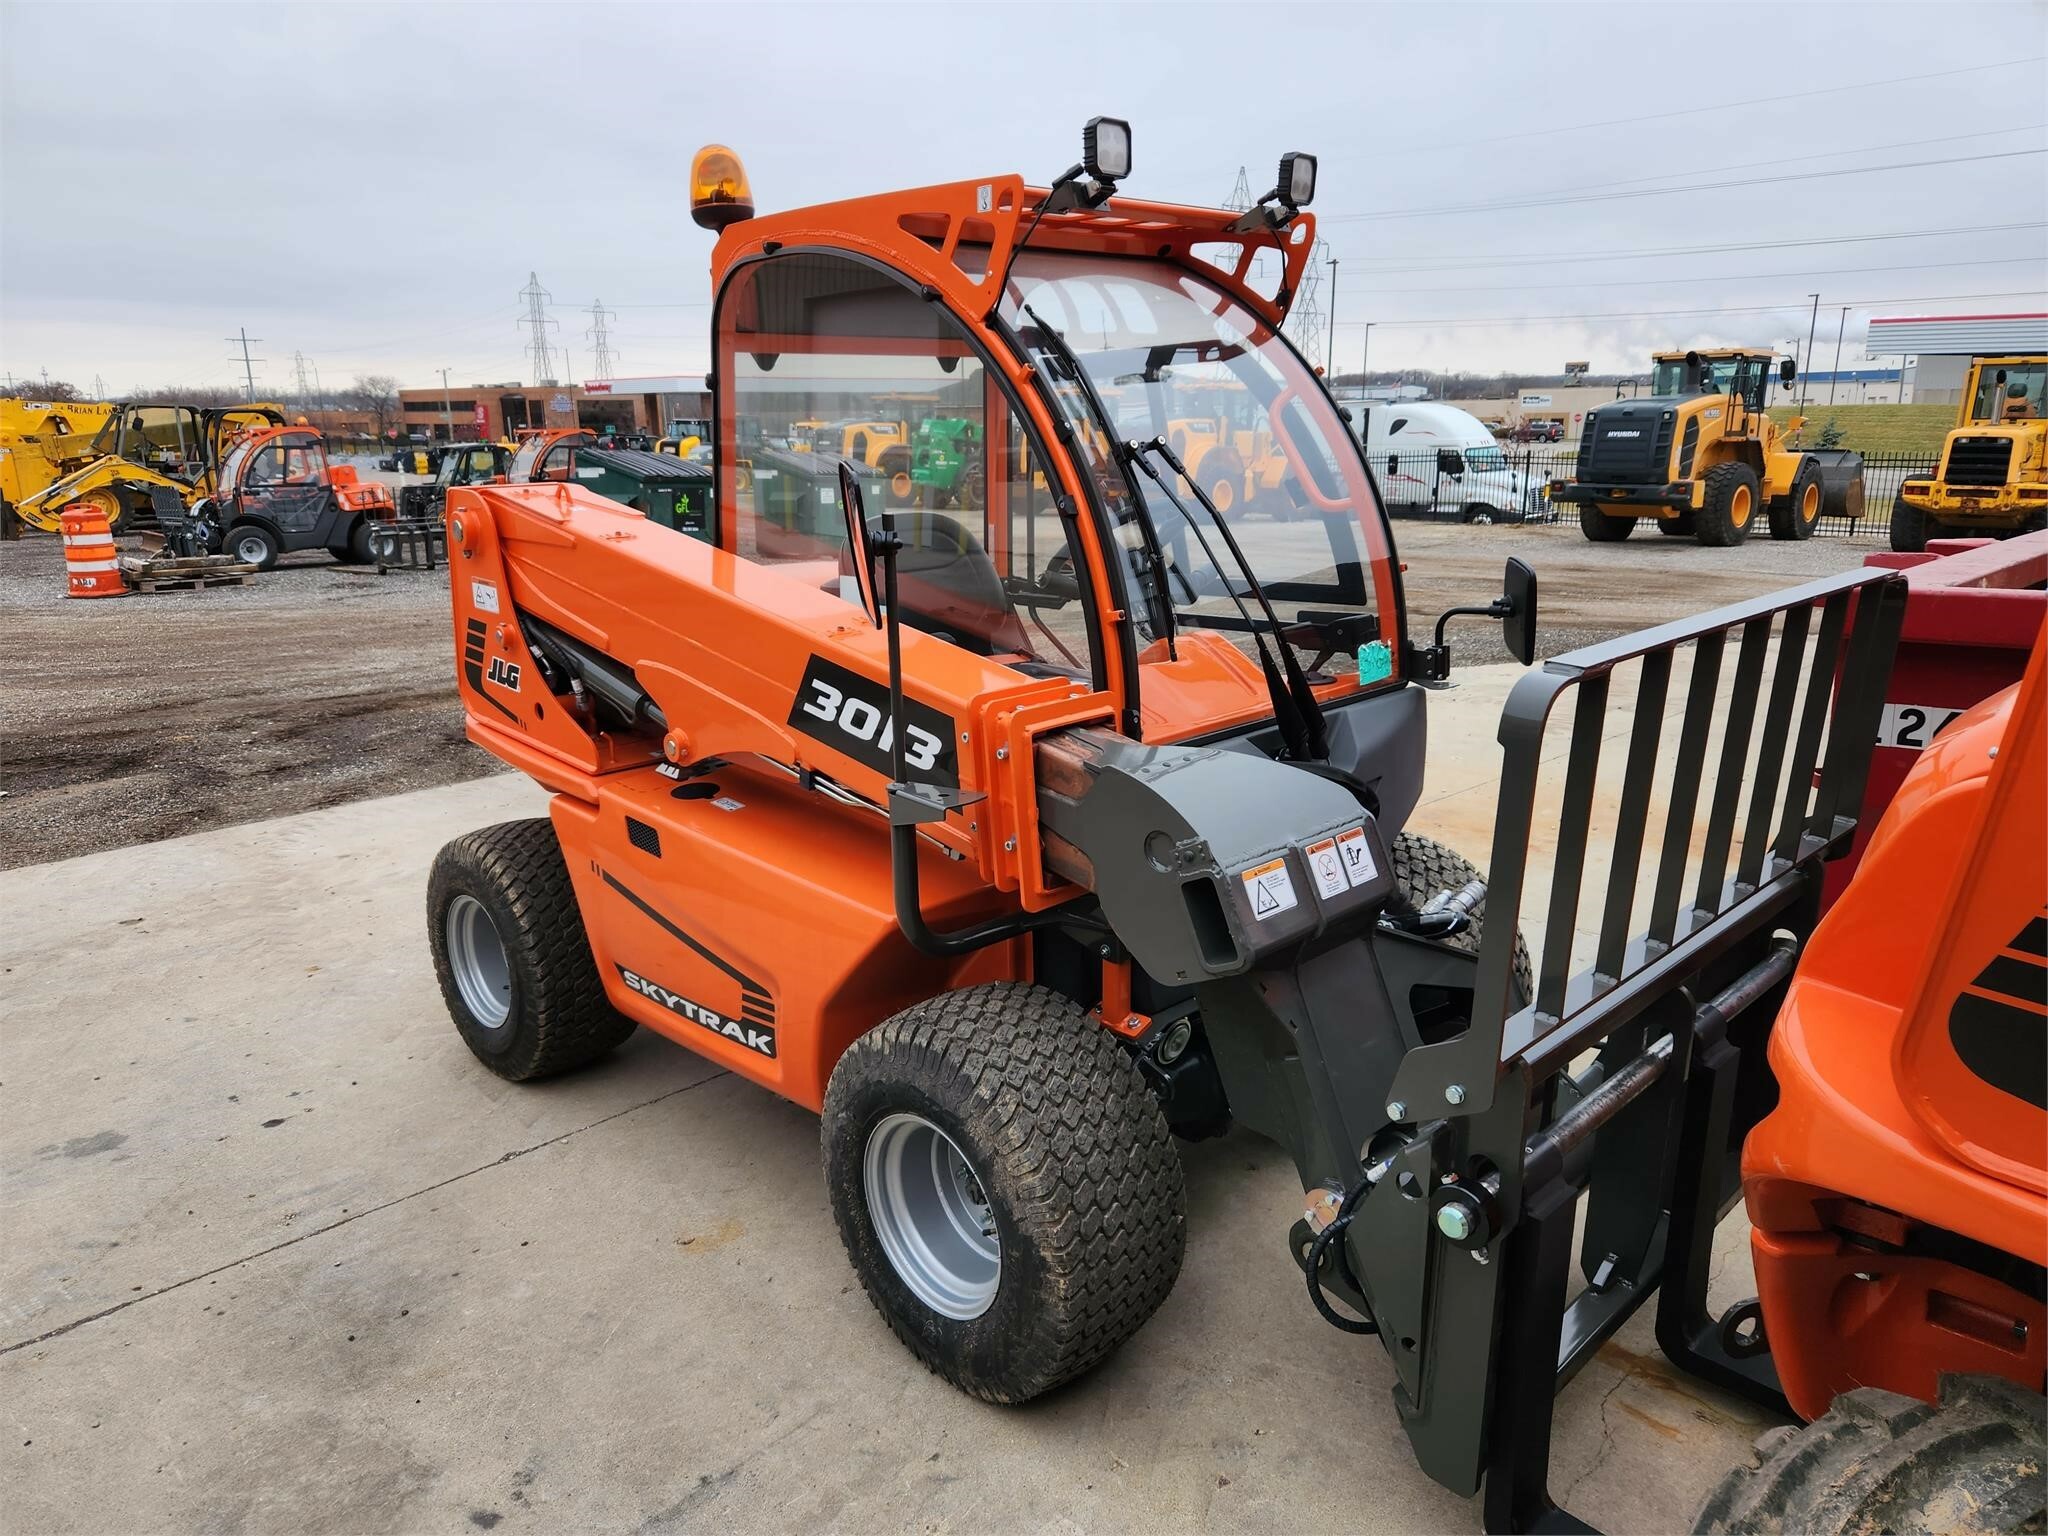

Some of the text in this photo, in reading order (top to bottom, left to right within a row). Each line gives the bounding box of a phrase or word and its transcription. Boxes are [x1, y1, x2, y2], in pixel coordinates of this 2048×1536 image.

[1607, 430, 1641, 438] HYUNDAI
[675, 502, 690, 514] GFL
[487, 656, 521, 692] JLG
[803, 678, 942, 771] 3013
[623, 971, 773, 1055] SKYTRAK
